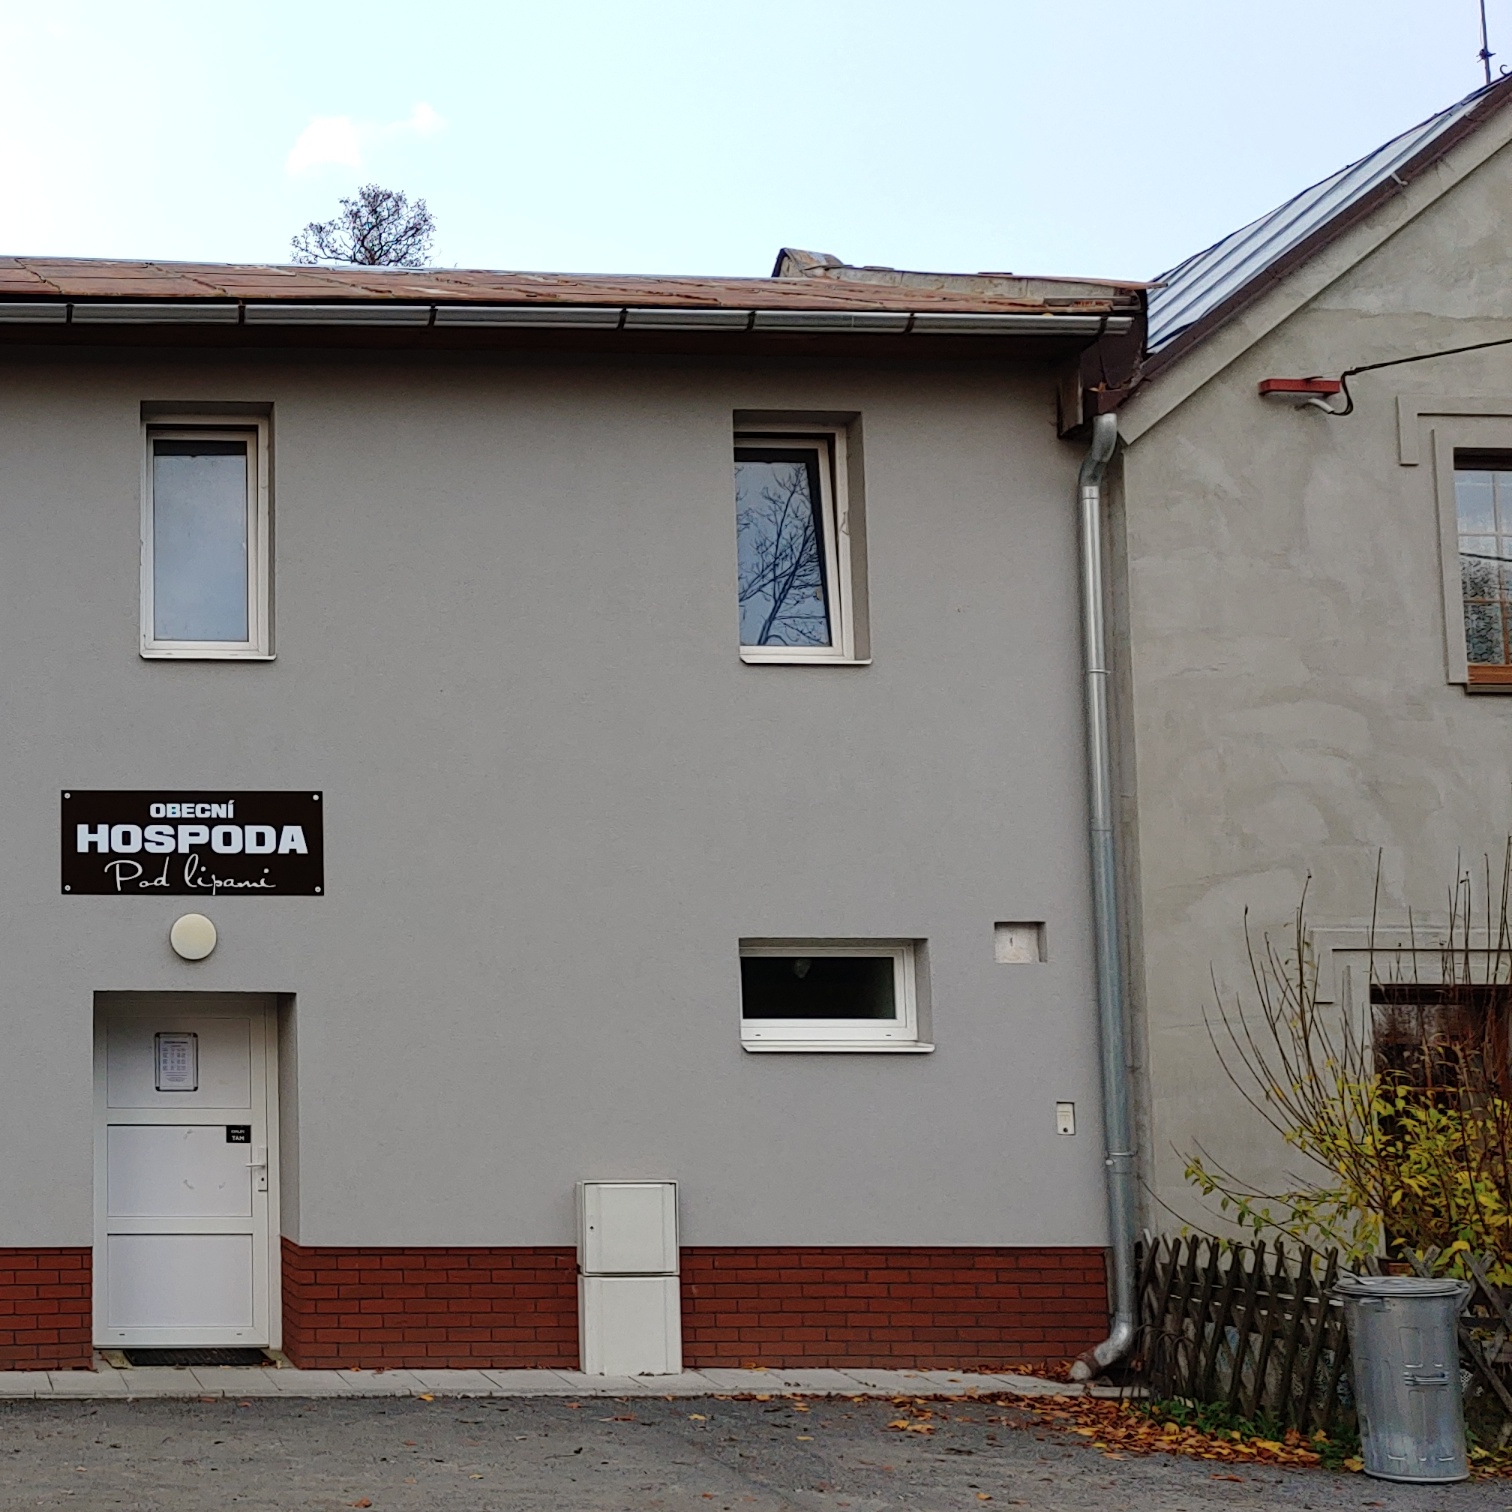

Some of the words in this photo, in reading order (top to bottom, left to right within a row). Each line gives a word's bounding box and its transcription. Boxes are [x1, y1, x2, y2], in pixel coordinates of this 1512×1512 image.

[149, 799, 235, 819] OBECNÍ
[76, 823, 309, 855] HOSPODA
[104, 856, 170, 892] Pod
[183, 853, 277, 895] lipami
